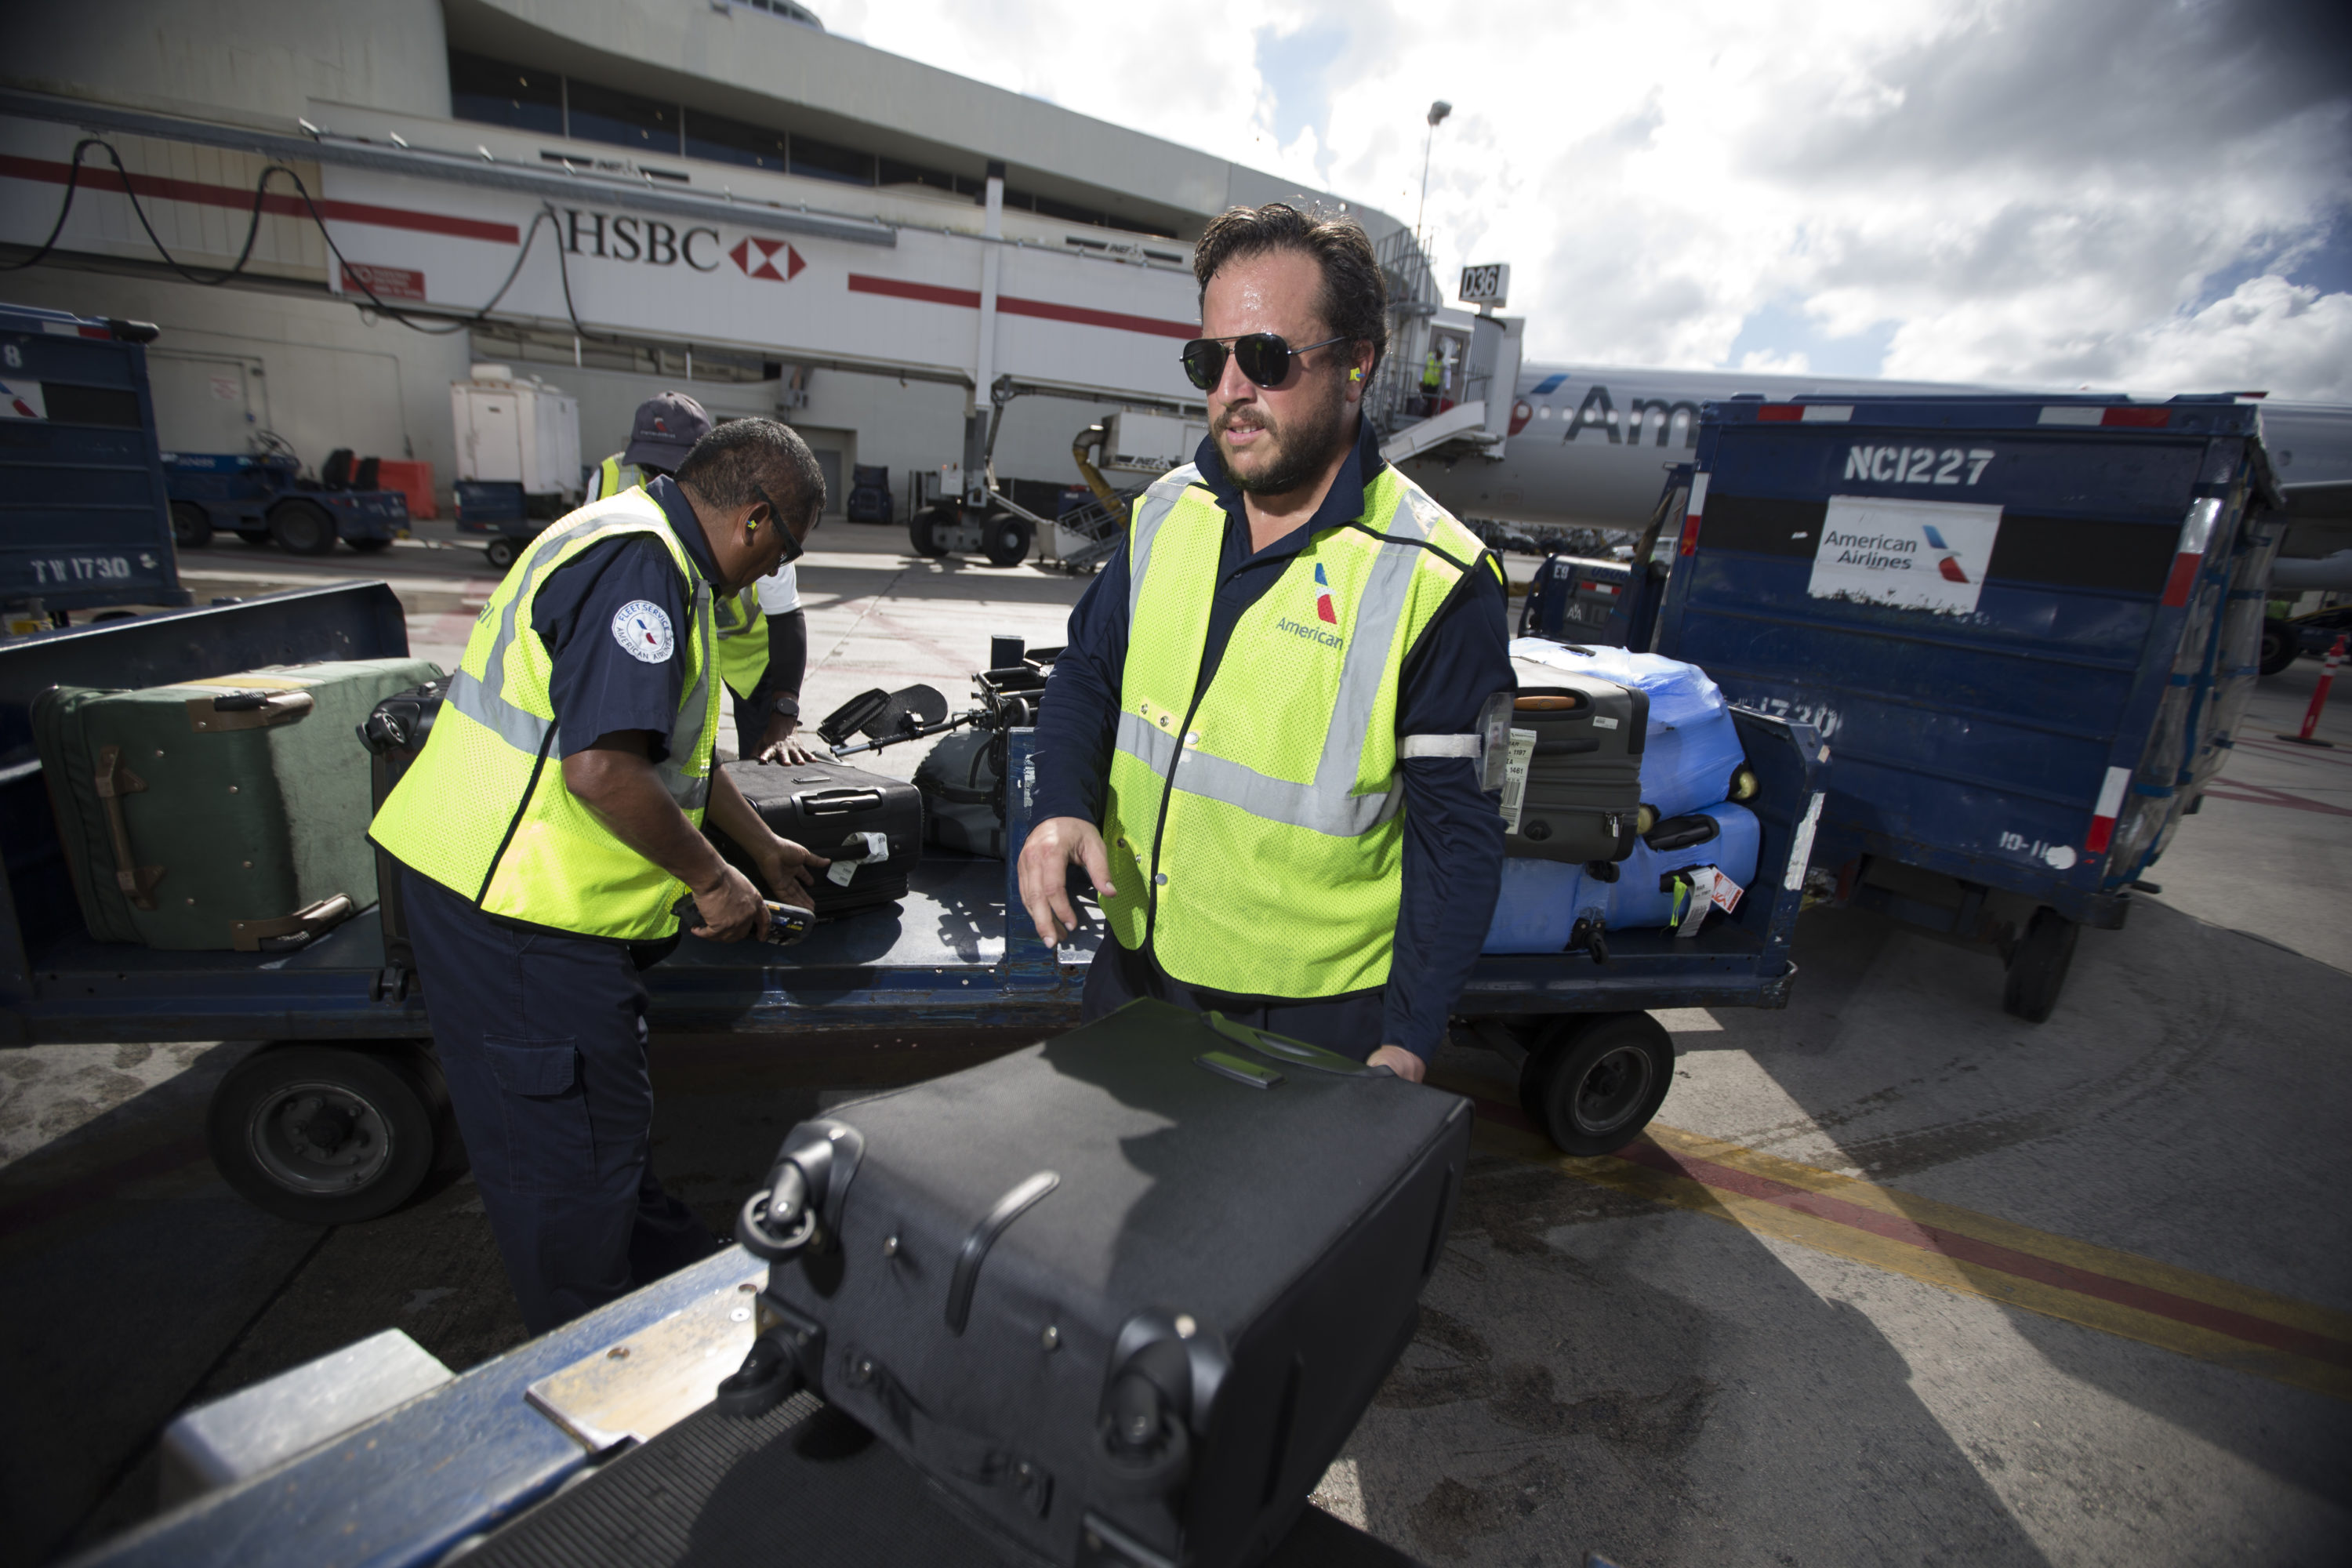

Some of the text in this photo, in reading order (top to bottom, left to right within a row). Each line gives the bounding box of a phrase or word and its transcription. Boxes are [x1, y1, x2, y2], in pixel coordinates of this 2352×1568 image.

[564, 208, 720, 272] HSBC
[1462, 266, 1497, 297] D36
[1844, 445, 1995, 486] NC1227
[1824, 531, 1918, 554] American
[1837, 550, 1912, 570] Airlines
[618, 604, 670, 631] FLEET SERVICE
[616, 626, 649, 660] AMERICAN
[1276, 617, 1344, 651] American
